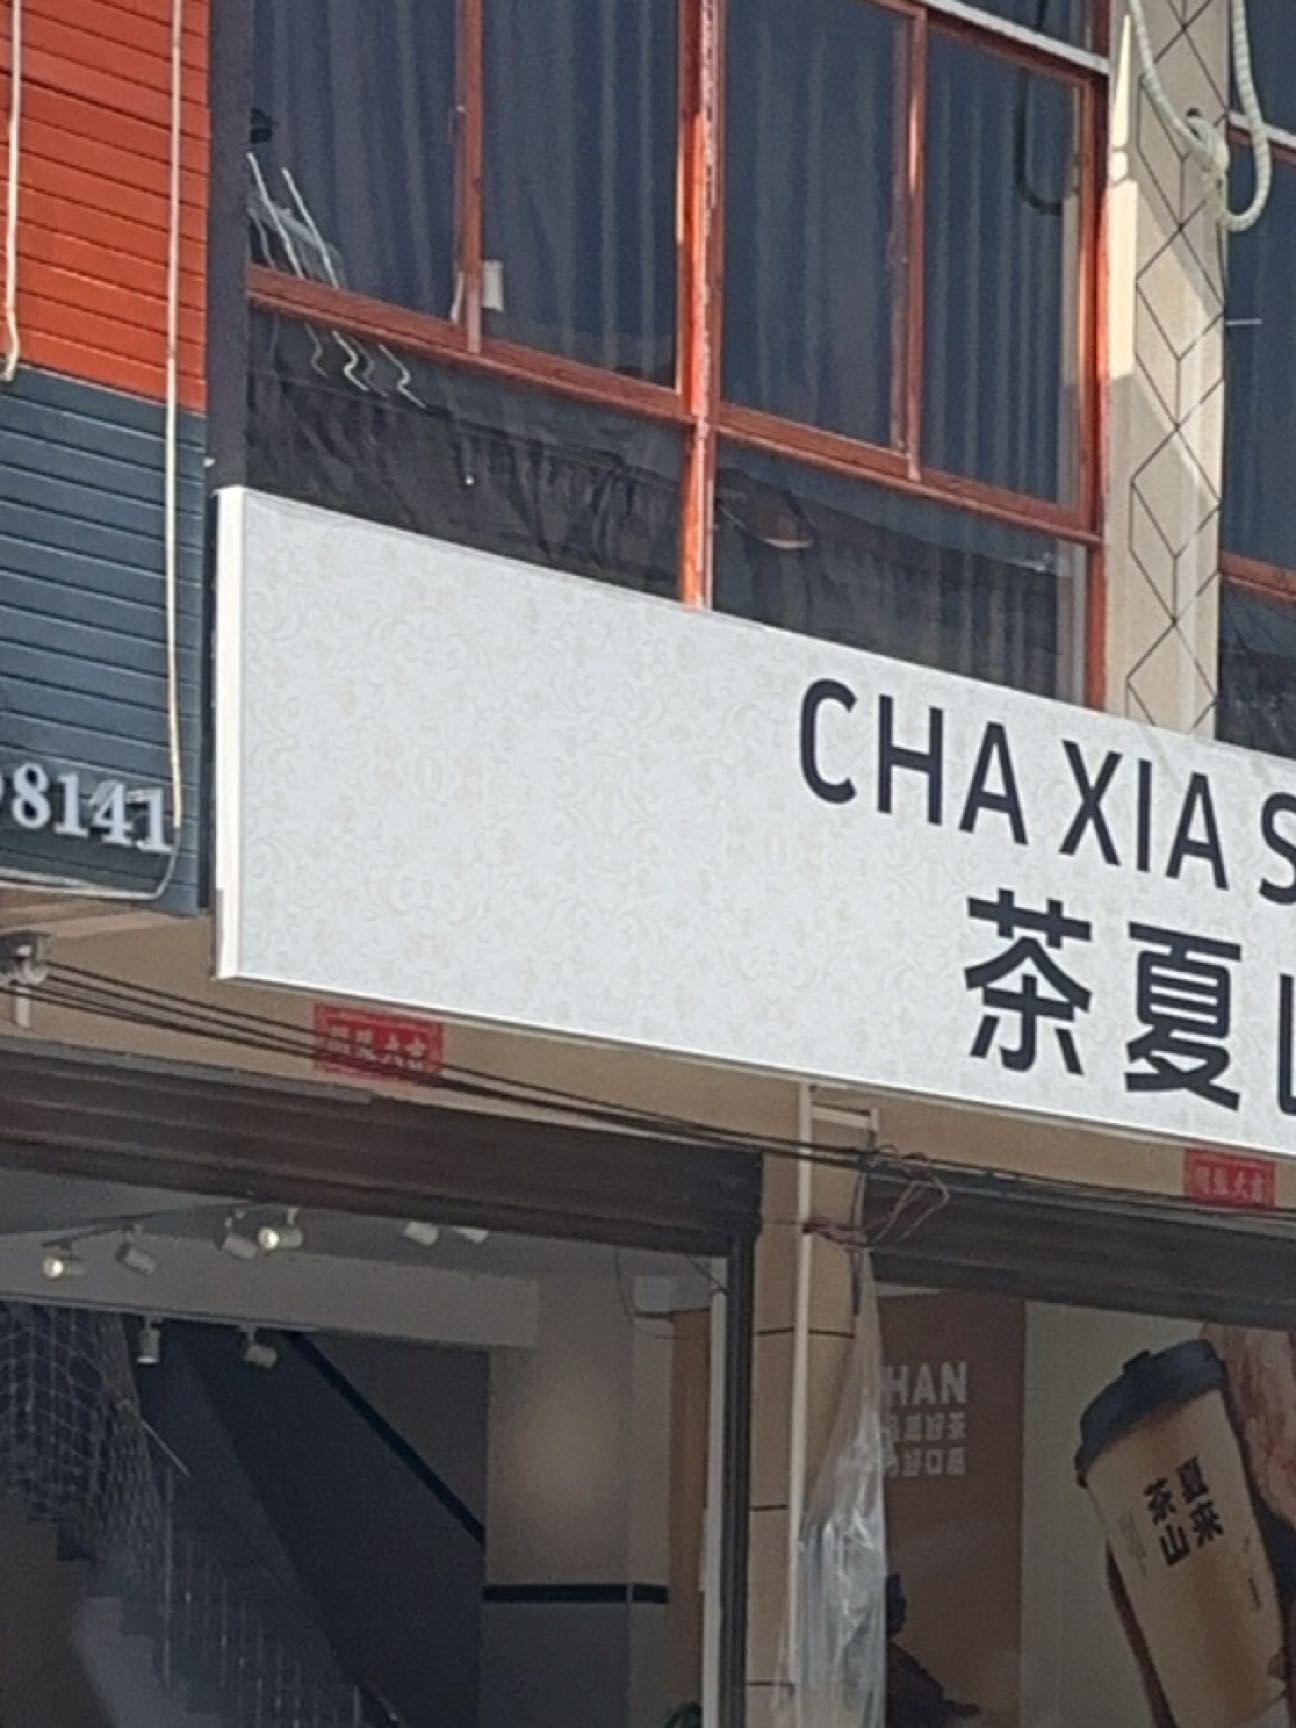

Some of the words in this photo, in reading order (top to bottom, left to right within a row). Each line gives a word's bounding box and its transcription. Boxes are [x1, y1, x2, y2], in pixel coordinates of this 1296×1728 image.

[0, 763, 172, 852] 8141
[800, 677, 1028, 846] CHA
[1060, 739, 1228, 891] XIA
